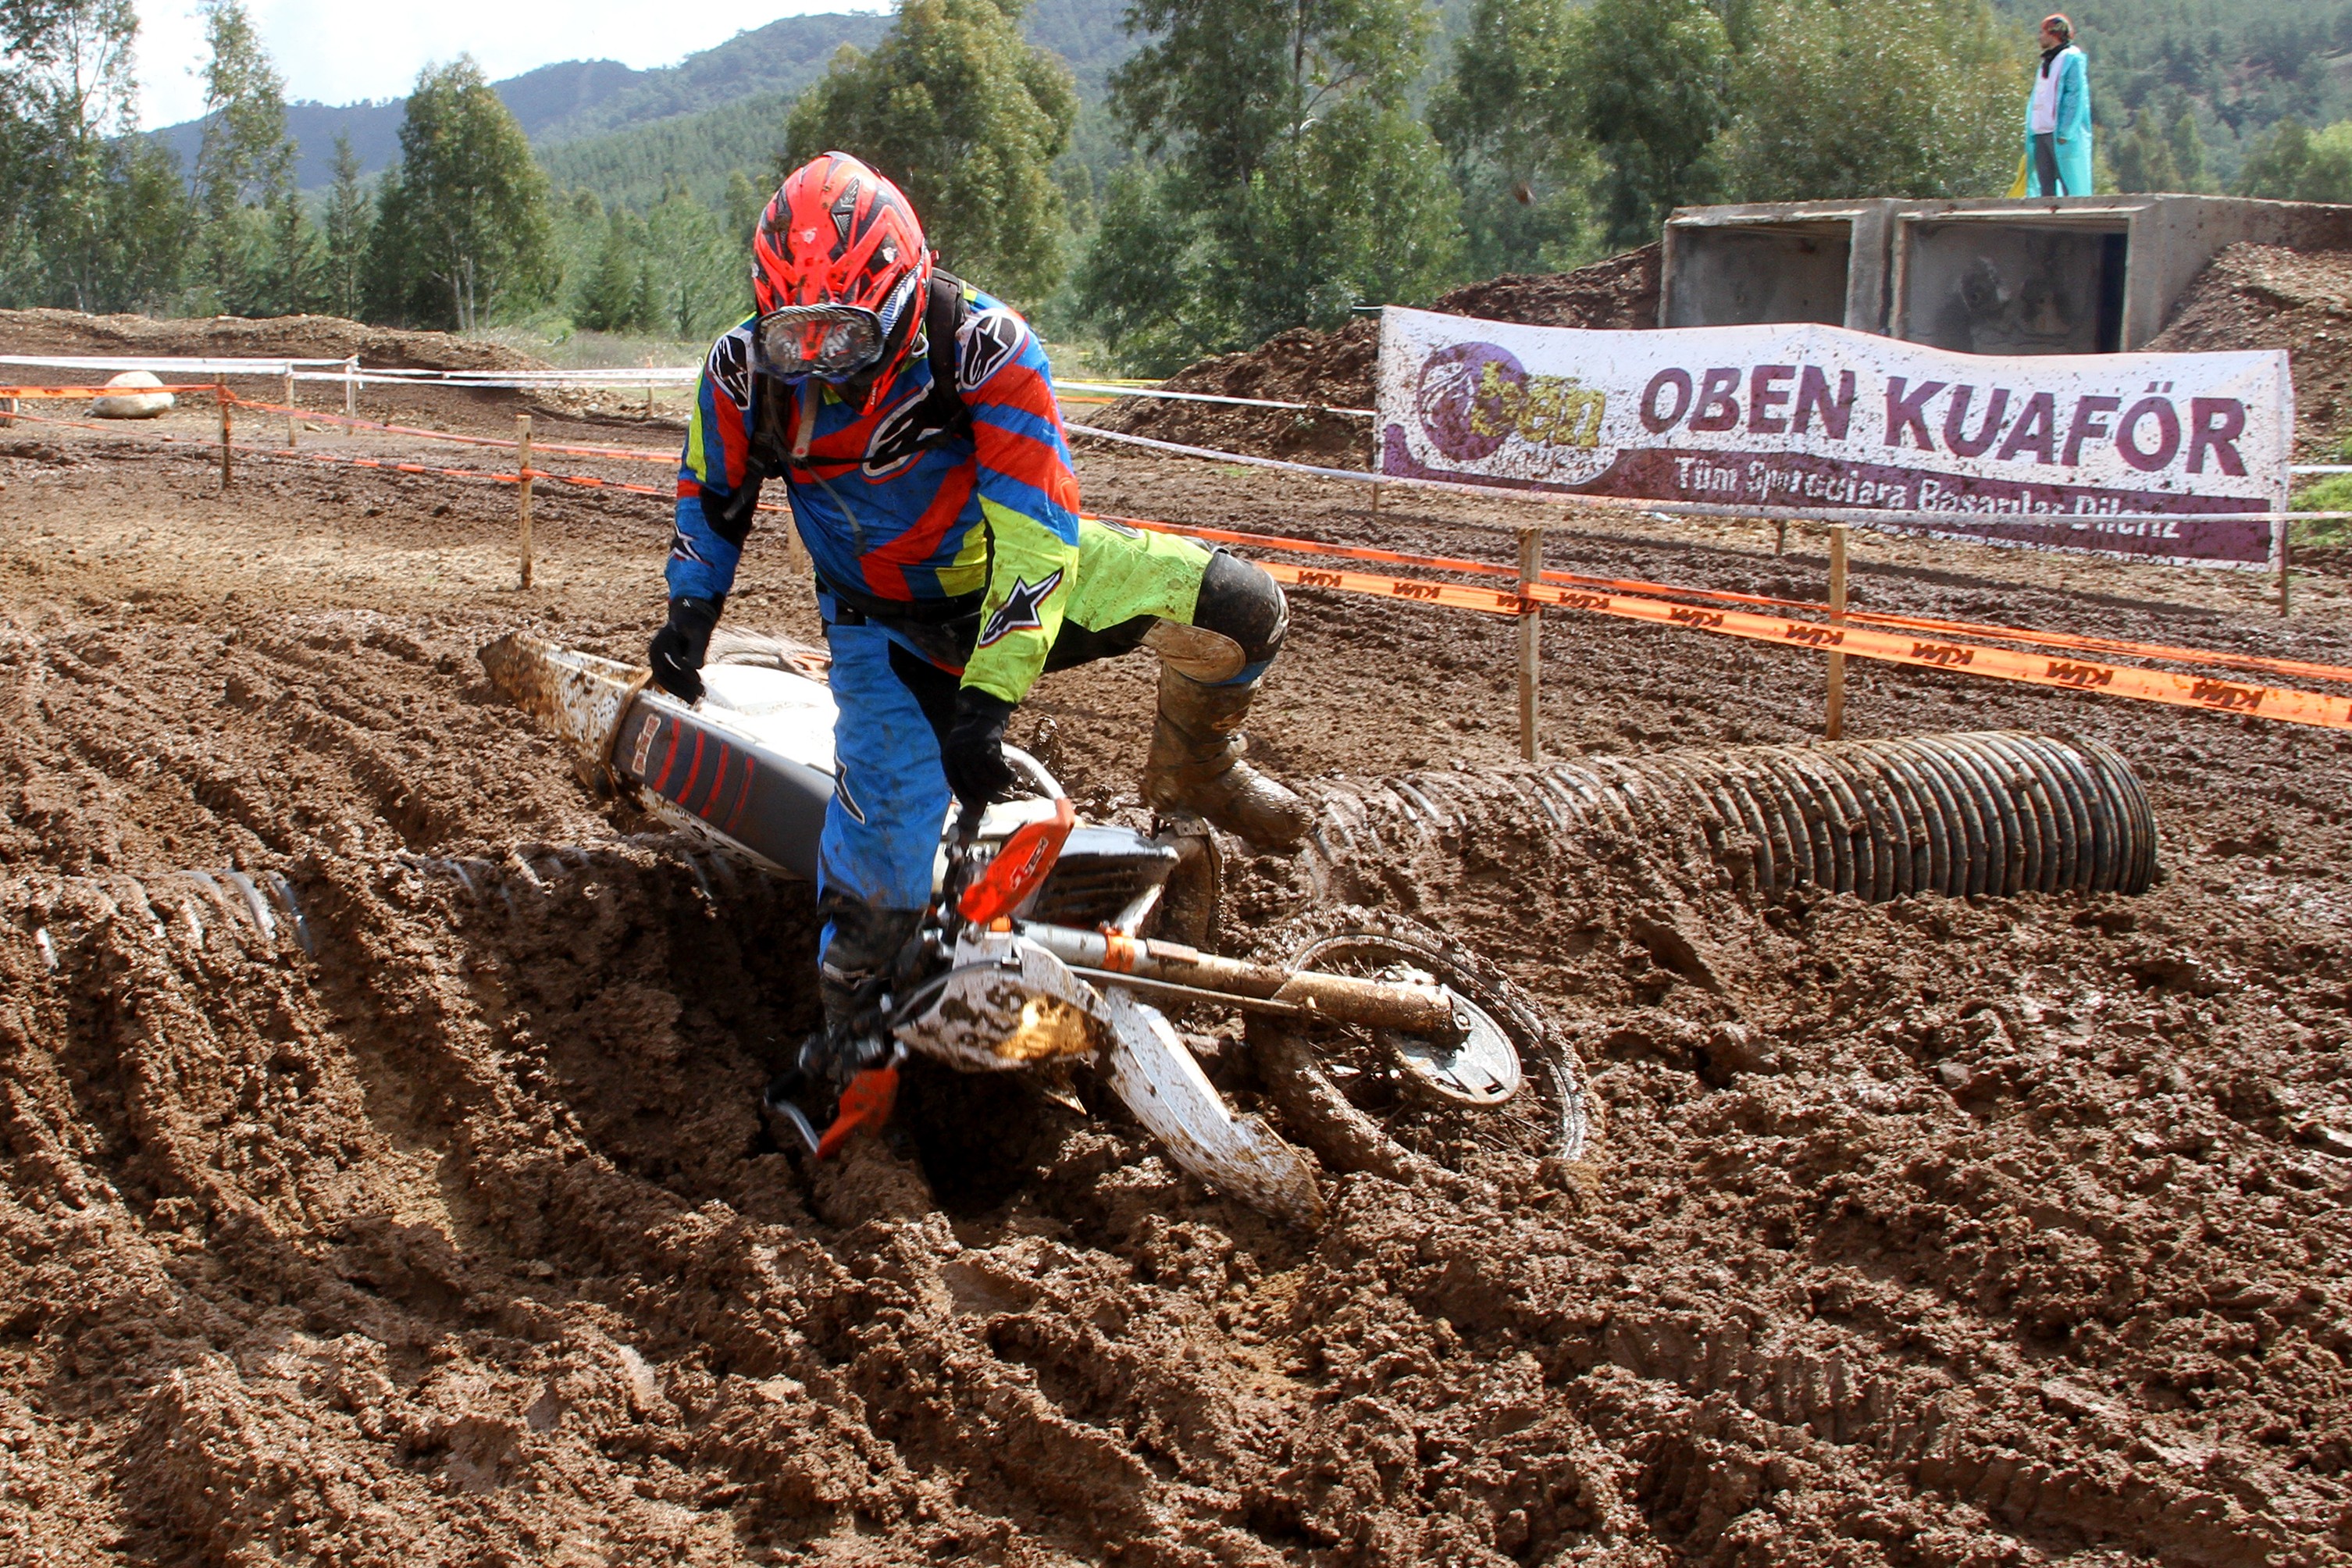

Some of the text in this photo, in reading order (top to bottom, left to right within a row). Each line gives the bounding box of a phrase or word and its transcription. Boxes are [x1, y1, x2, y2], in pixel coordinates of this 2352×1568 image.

[1639, 365, 2249, 476] OBEN KUAFÖR
[1674, 456, 1739, 492] Tüm
[1297, 570, 1342, 589] KTM
[1392, 582, 1441, 600] KTM
[1559, 591, 1611, 612] KTM
[1670, 606, 1725, 627] KTM
[1785, 624, 1845, 647] KTM
[1911, 642, 1976, 667] KTM
[2046, 661, 2115, 690] KTM
[2189, 678, 2266, 711] KTM
